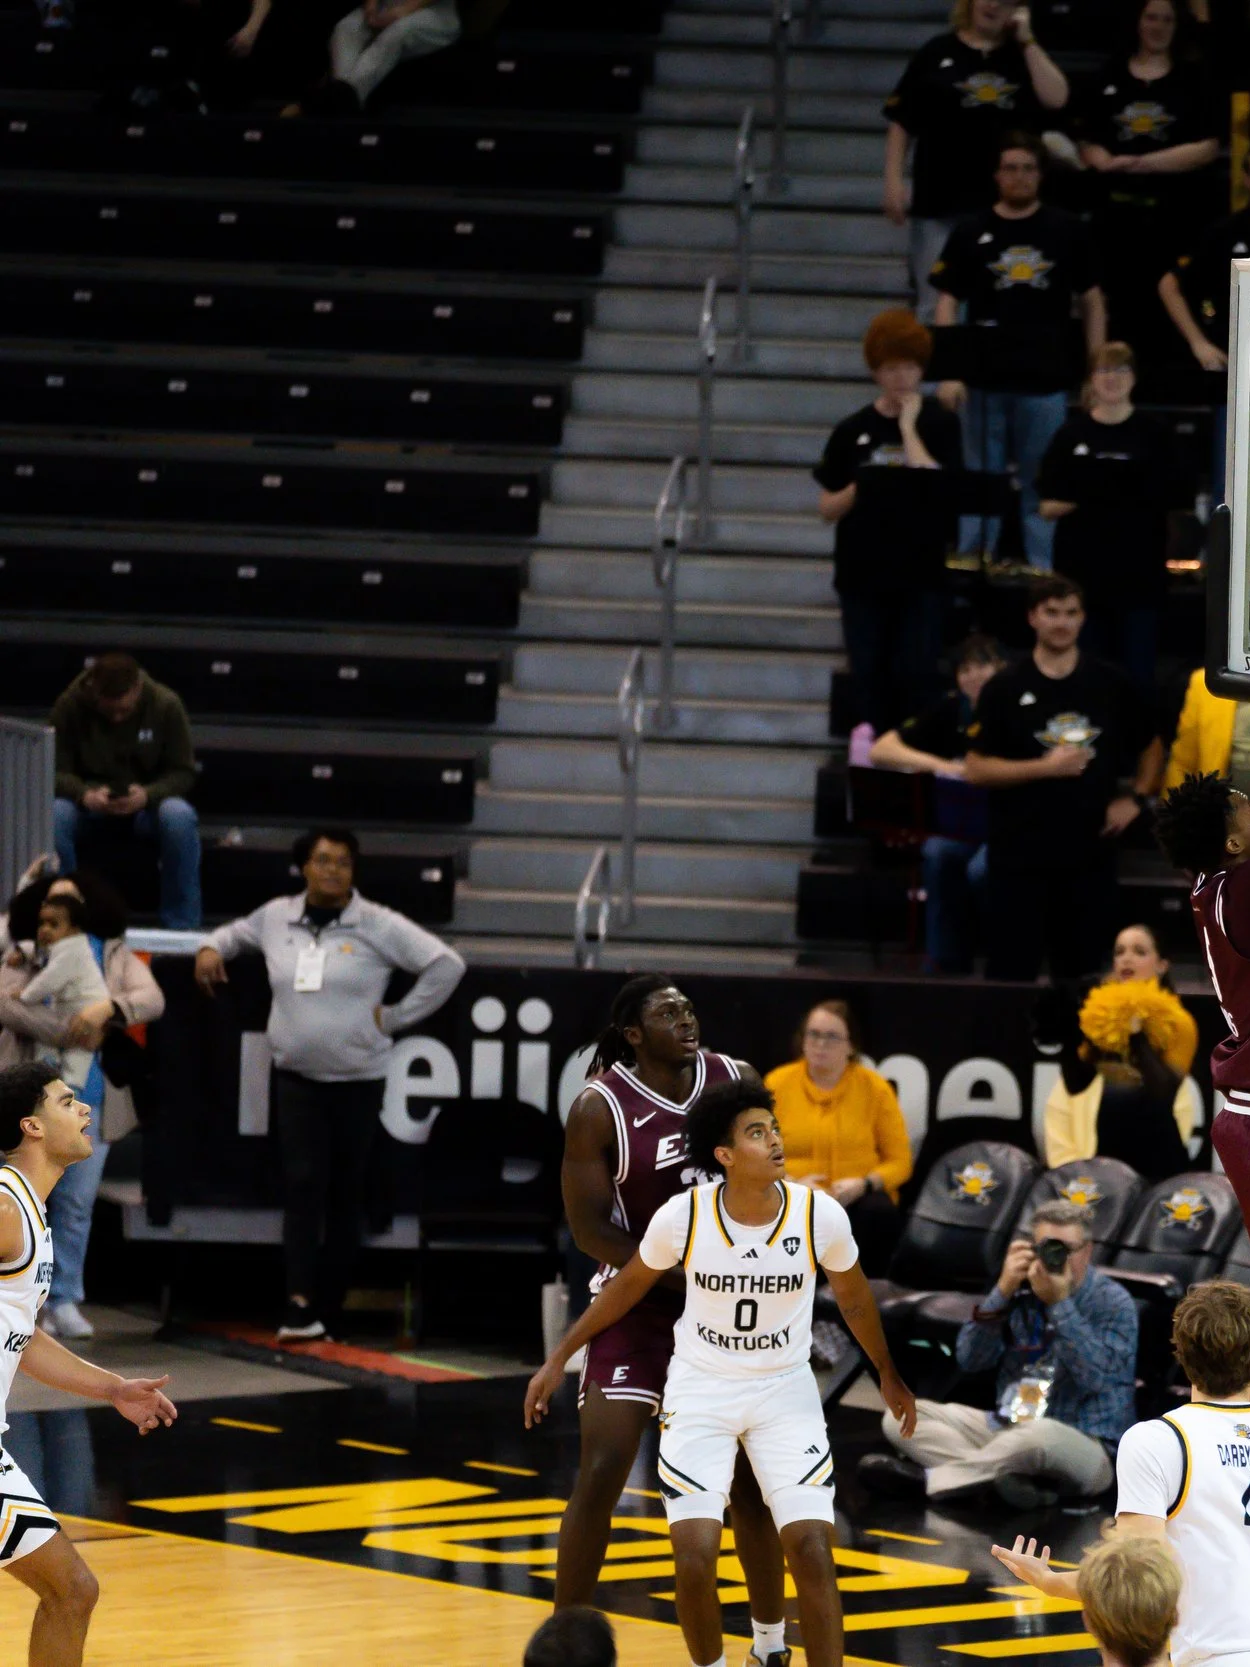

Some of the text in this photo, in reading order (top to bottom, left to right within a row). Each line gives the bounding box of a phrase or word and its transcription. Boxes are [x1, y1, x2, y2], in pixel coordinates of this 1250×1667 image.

[694, 1271, 804, 1294] NORTHERN
[734, 1299, 758, 1332] 0
[697, 1322, 791, 1351] KENTUCKY
